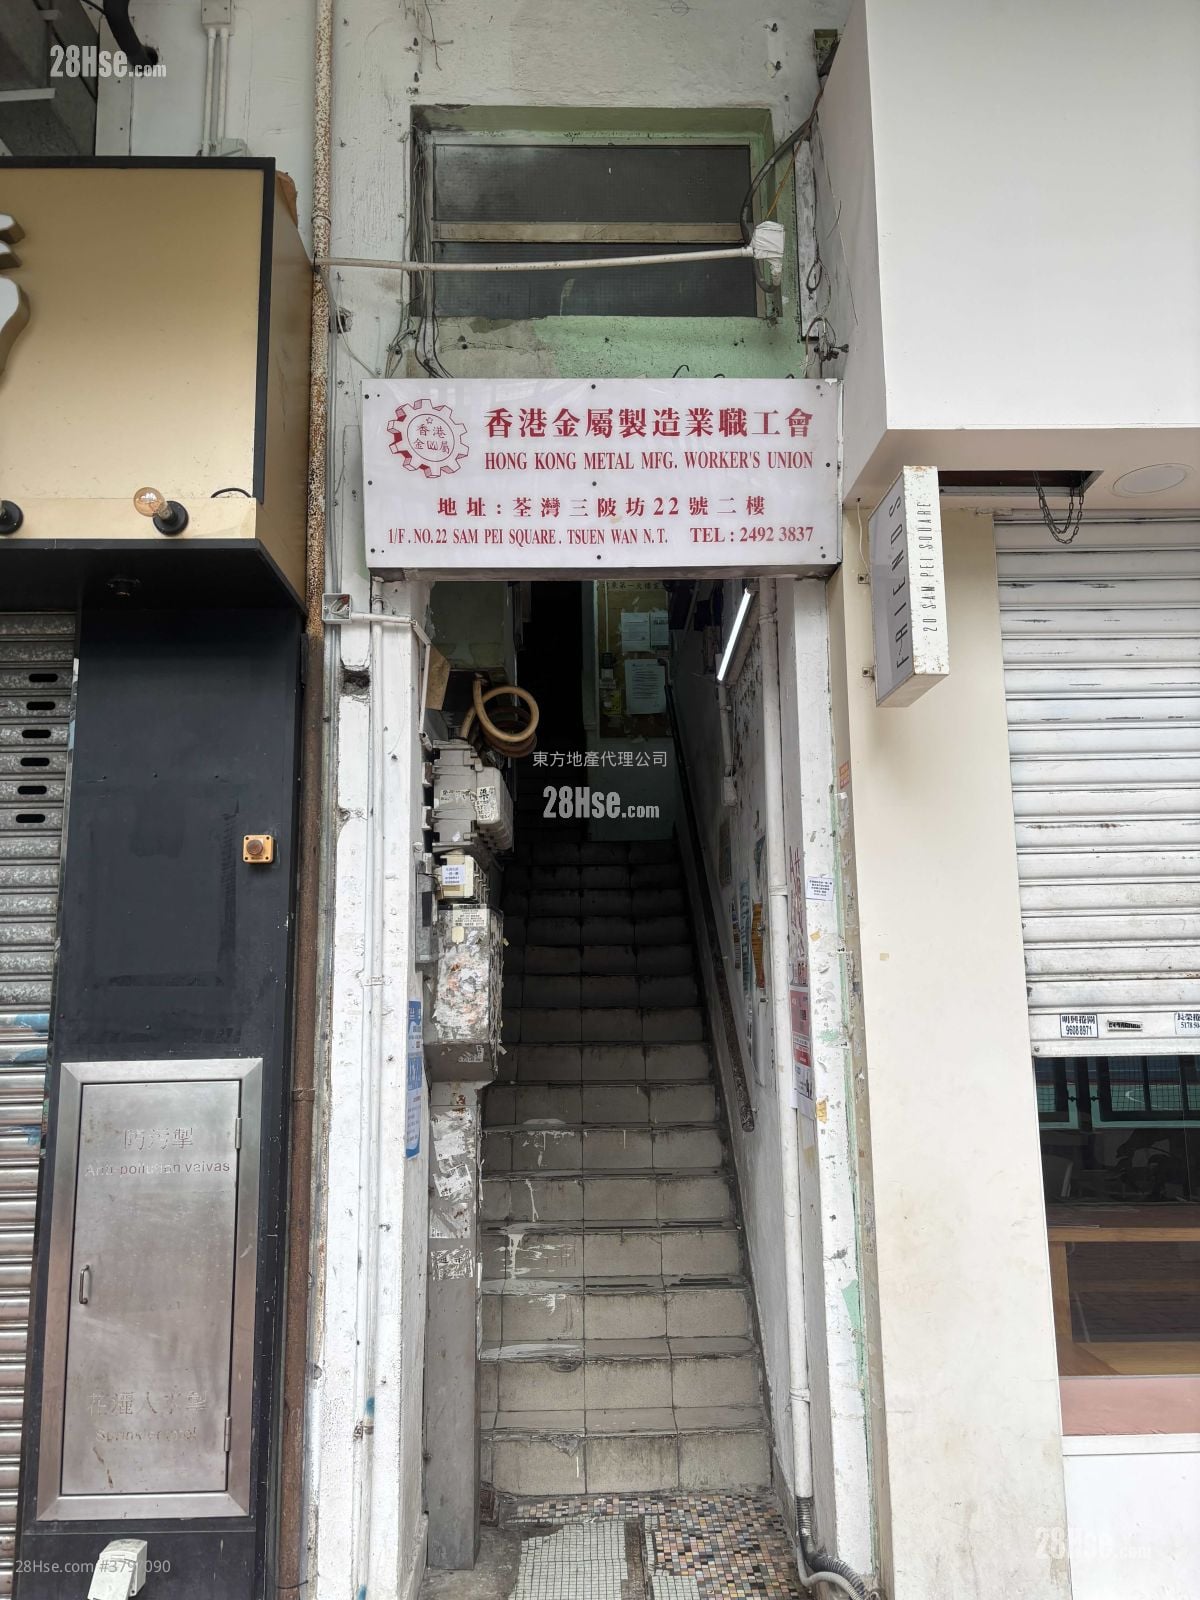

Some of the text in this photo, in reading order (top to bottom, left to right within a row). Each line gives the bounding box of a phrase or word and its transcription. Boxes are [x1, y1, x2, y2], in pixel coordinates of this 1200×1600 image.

[484, 407, 814, 439] 香港金屬製造業職工會
[485, 451, 813, 470] HONG KONG METAL MFG. WORKER'S UNION
[453, 529, 479, 544] SAM
[484, 529, 503, 544] PEI
[567, 529, 605, 544] TSUEN
[611, 528, 638, 544] WAN
[778, 526, 814, 542] 3837
[916, 503, 938, 632] 20 SAM PEI SQUARE
